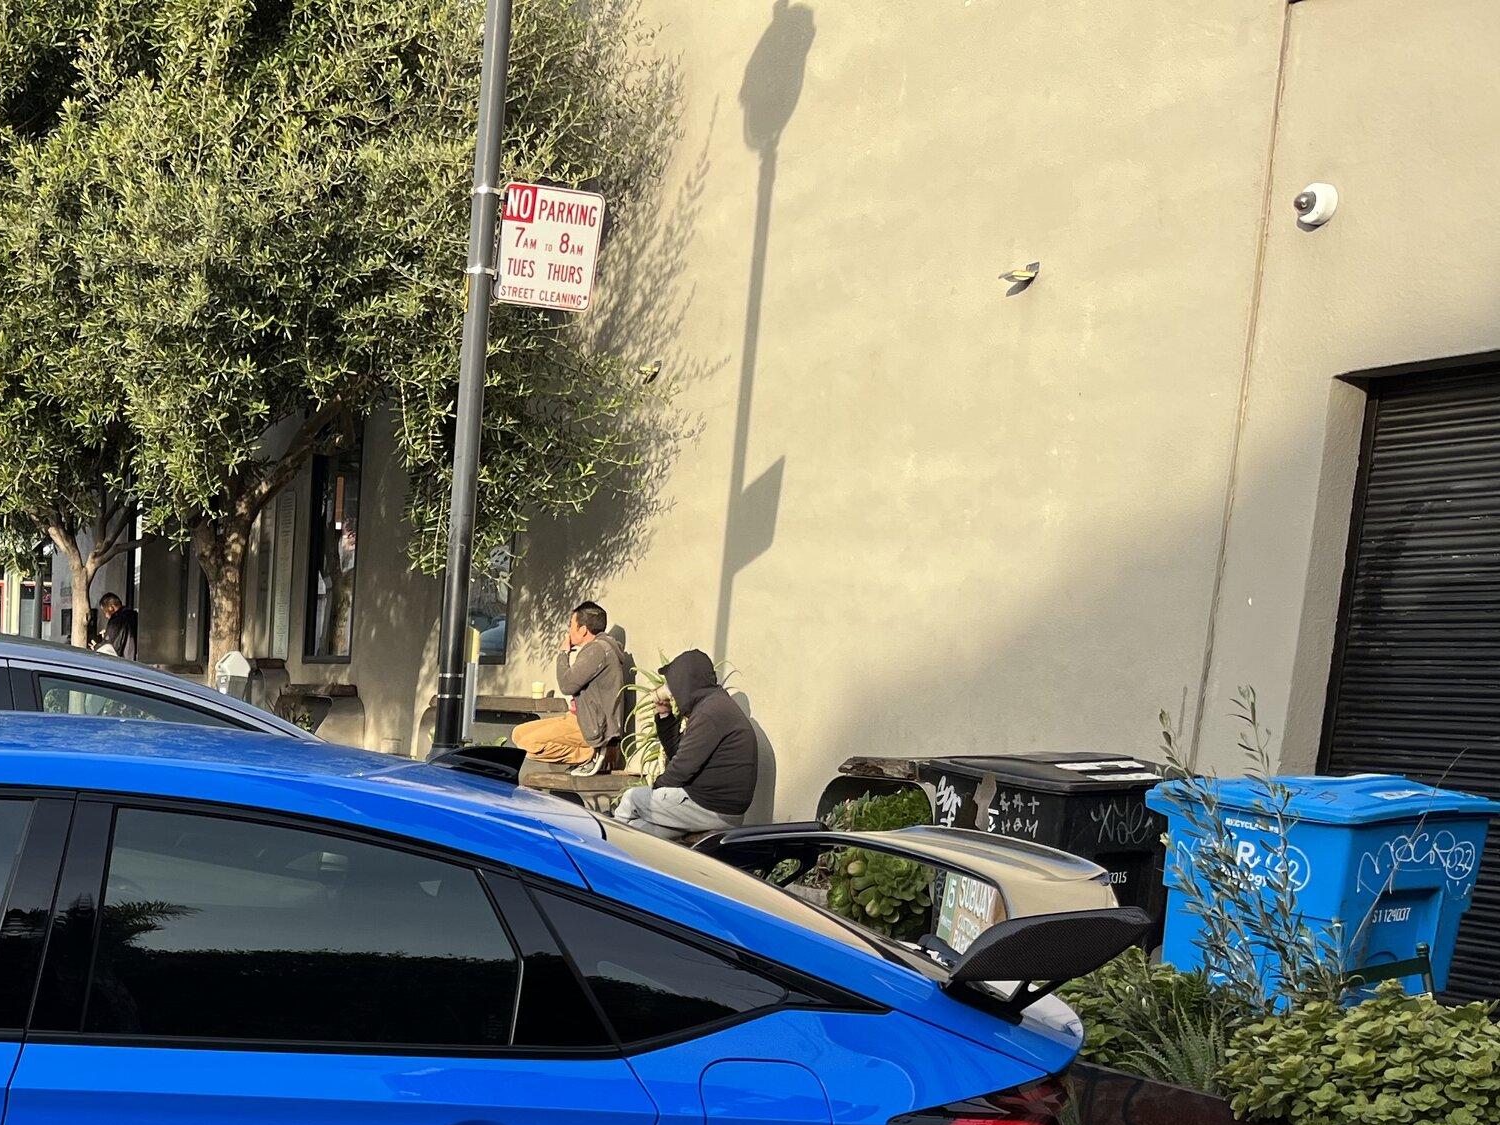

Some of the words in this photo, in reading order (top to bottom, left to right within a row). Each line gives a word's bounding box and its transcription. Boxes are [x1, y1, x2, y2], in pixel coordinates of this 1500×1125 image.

[506, 187, 533, 219] NO
[538, 199, 598, 227] PARKING
[507, 257, 536, 278] TUES
[547, 262, 583, 285] THURS
[500, 285, 534, 299] STREET
[539, 289, 582, 306] CLEANING
[1225, 817, 1279, 834] RECYCLAES
